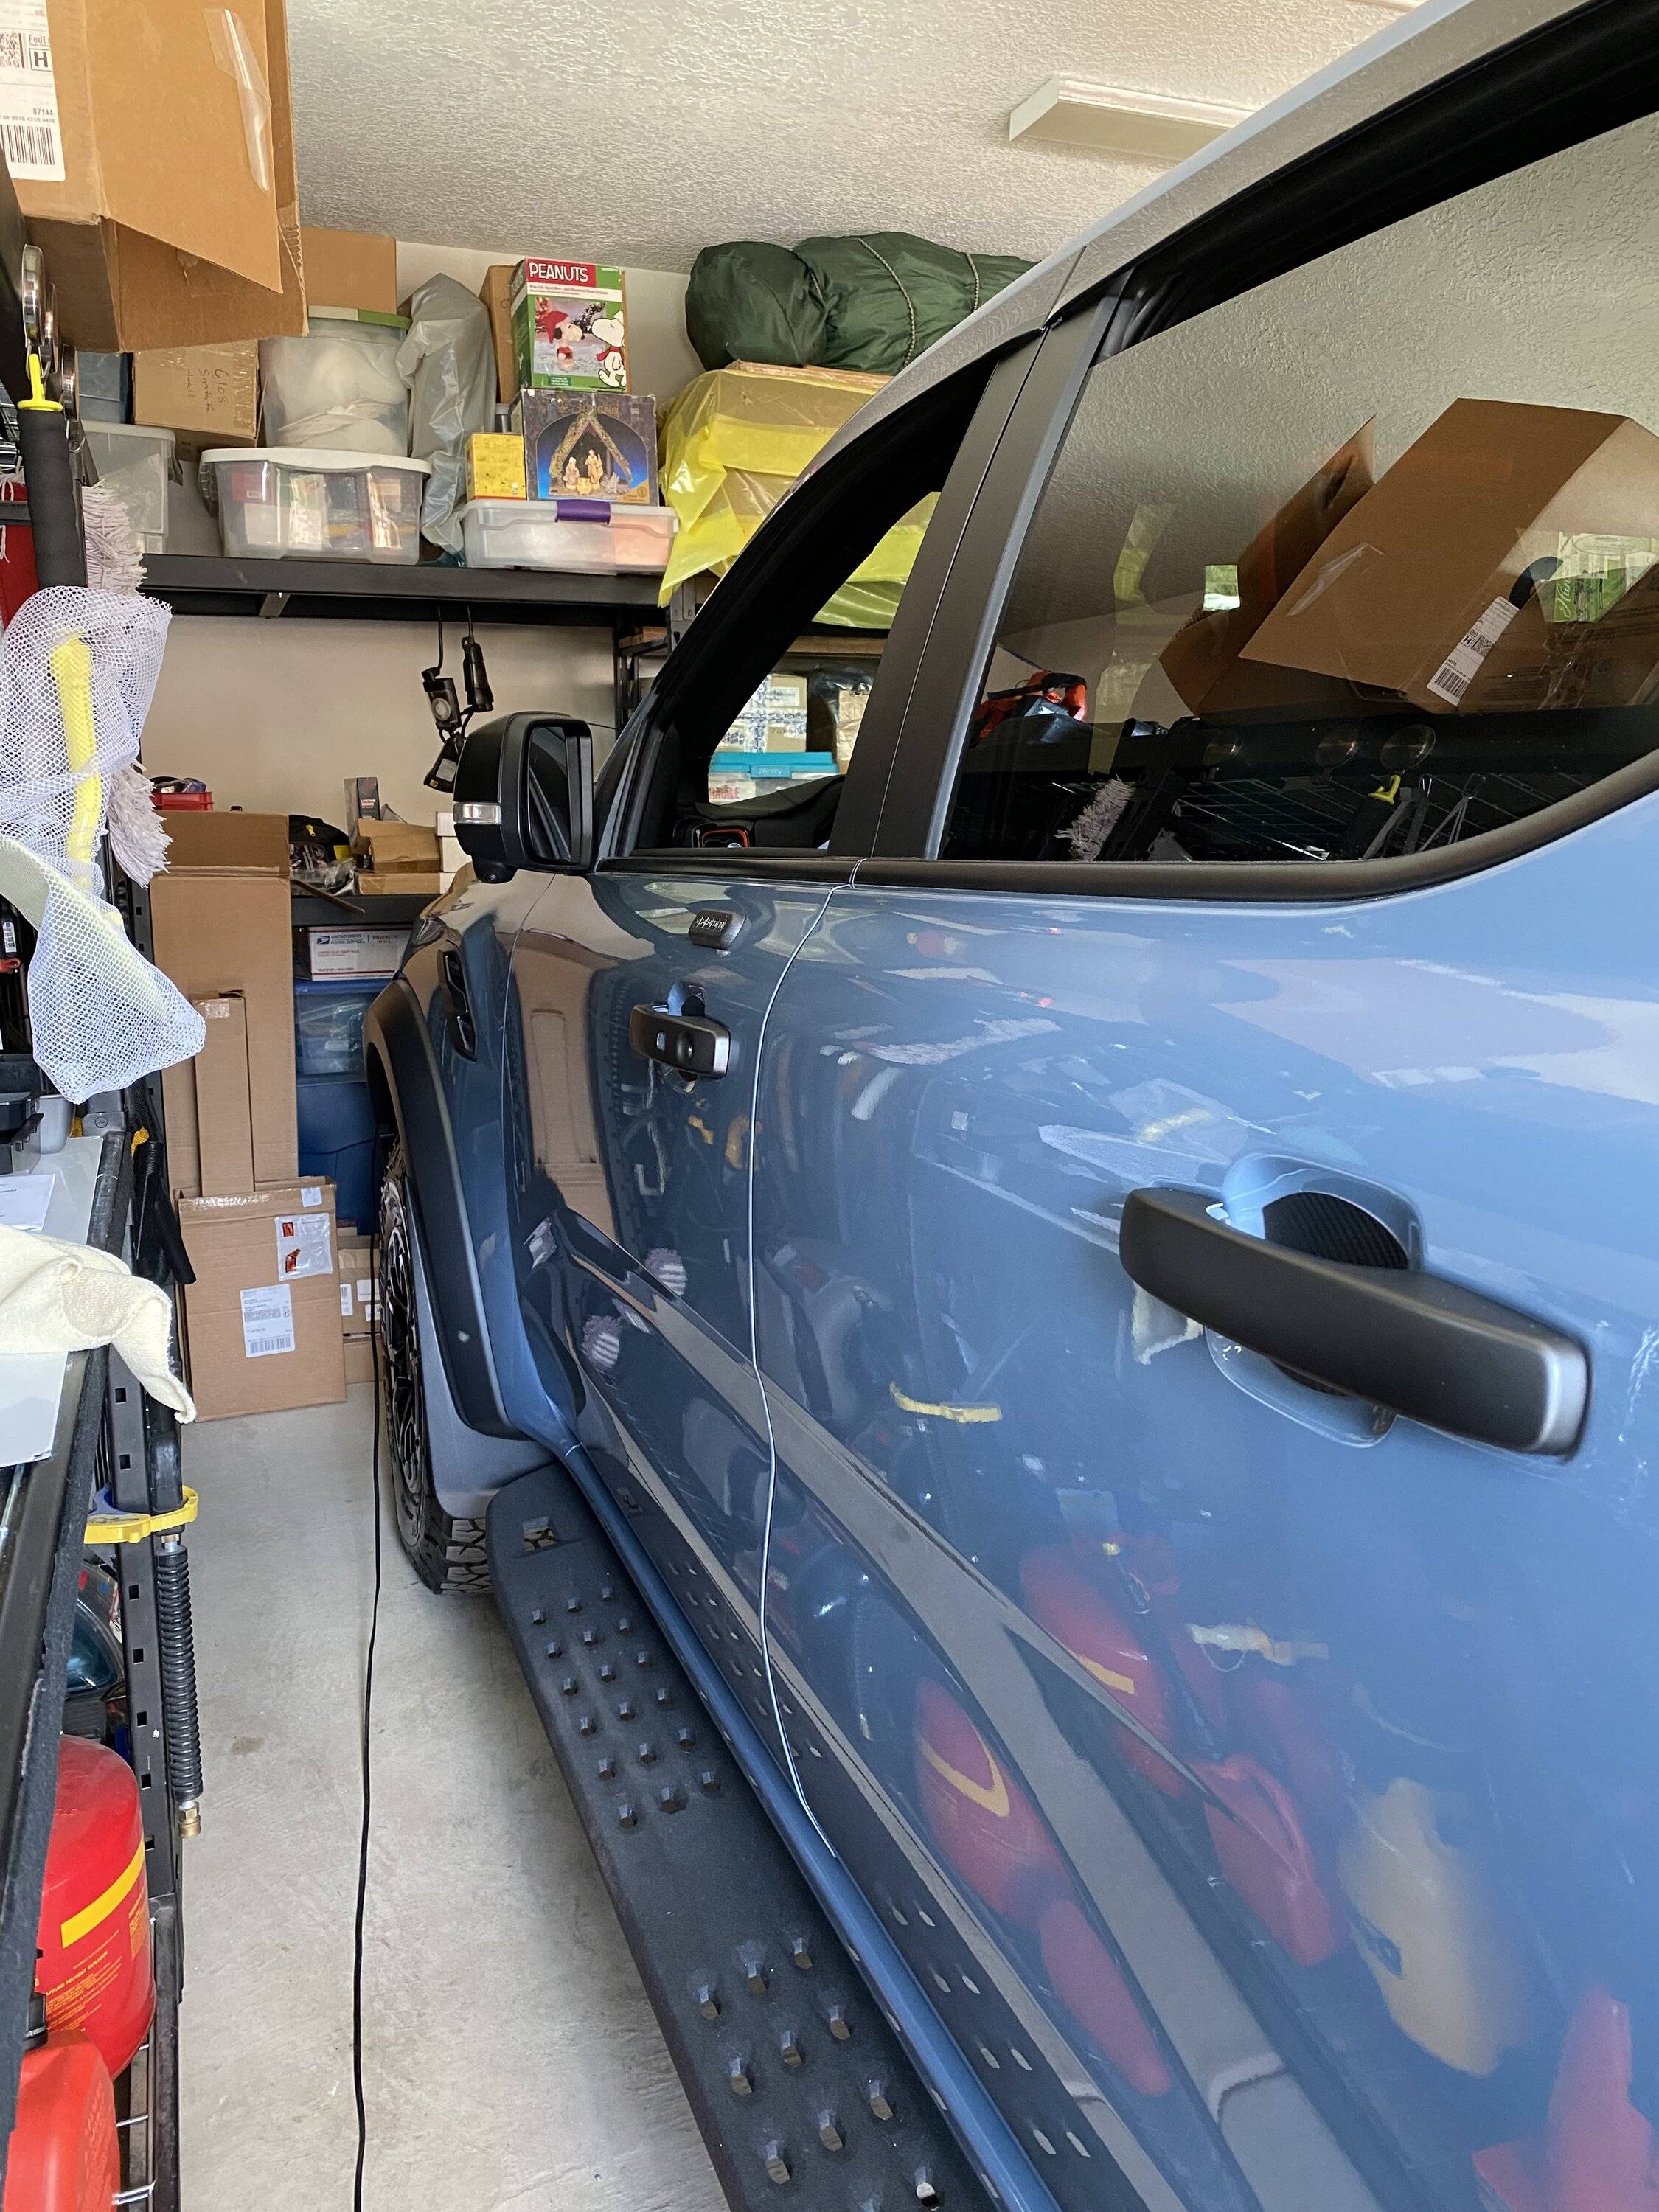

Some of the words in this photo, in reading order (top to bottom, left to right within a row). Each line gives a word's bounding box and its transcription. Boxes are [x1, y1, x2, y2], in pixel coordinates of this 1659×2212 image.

[34, 51, 48, 68] H
[32, 108, 53, 116] 87144
[529, 262, 589, 282] PEANUTS
